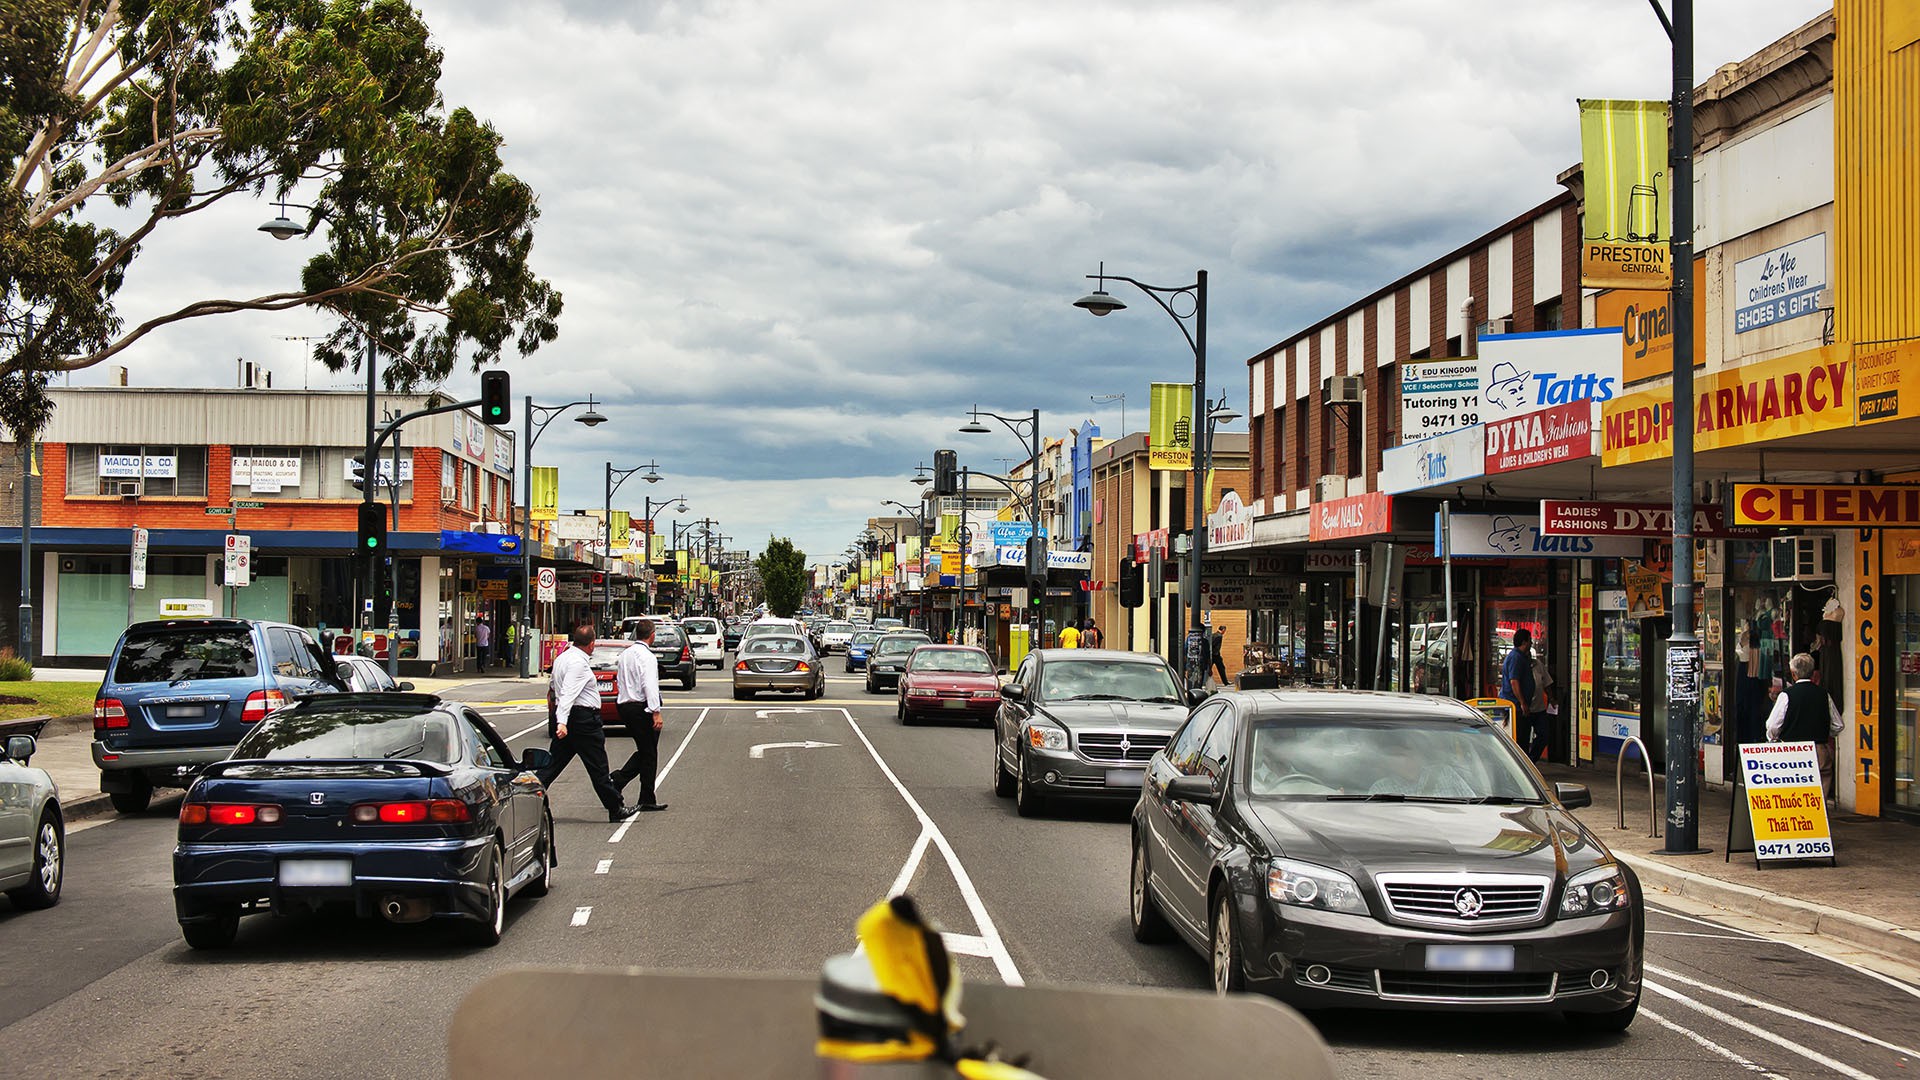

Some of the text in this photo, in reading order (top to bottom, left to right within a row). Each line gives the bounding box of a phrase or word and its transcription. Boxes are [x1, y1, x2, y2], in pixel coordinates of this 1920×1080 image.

[1590, 246, 1664, 263] PRESTON
[1621, 263, 1664, 273] CENTRAL
[1760, 252, 1796, 280] Le-Yee
[1749, 275, 1808, 302] Childrens Wear
[1738, 289, 1820, 329] SHOES & GIFTS
[1422, 366, 1477, 376] EDU KINGDOM
[1422, 381, 1453, 390] Selective
[1861, 373, 1881, 390] VARIETY
[1883, 369, 1901, 385] STORE
[1533, 373, 1614, 405] Tatts
[1404, 396, 1478, 409] Tutoring Y1
[1605, 361, 1848, 451] MEDIPARMARCY
[1860, 396, 1897, 415] OPEN 7 DAYS
[1422, 413, 1479, 428] 9471 99
[1487, 412, 1589, 457] DYNA Fashions
[104, 457, 173, 467] MAIOLO & CO.
[1152, 451, 1189, 459] PRESTON
[1500, 444, 1569, 469] LADIES & CHILDREN'S WEAR
[233, 459, 299, 468] F. A. MAIOLO & CO.
[1427, 452, 1447, 480] Tatts
[1557, 507, 1601, 516] LADIES'
[1741, 487, 1919, 522] CHEMI
[1340, 503, 1363, 529] NAILS
[1551, 520, 1608, 529] FASHIONS
[997, 528, 1016, 538] Afro
[501, 540, 516, 549] Snap
[540, 574, 552, 584] 40
[1859, 529, 1875, 784] DISCOUNT
[1618, 722, 1630, 737] Tatts
[1747, 760, 1814, 770] Discount
[1751, 773, 1815, 785] Chemist
[1751, 792, 1821, 811] Nhà Thuốc Tây
[1767, 815, 1814, 832] Thái Trần
[1758, 842, 1831, 855] 9471 2056
